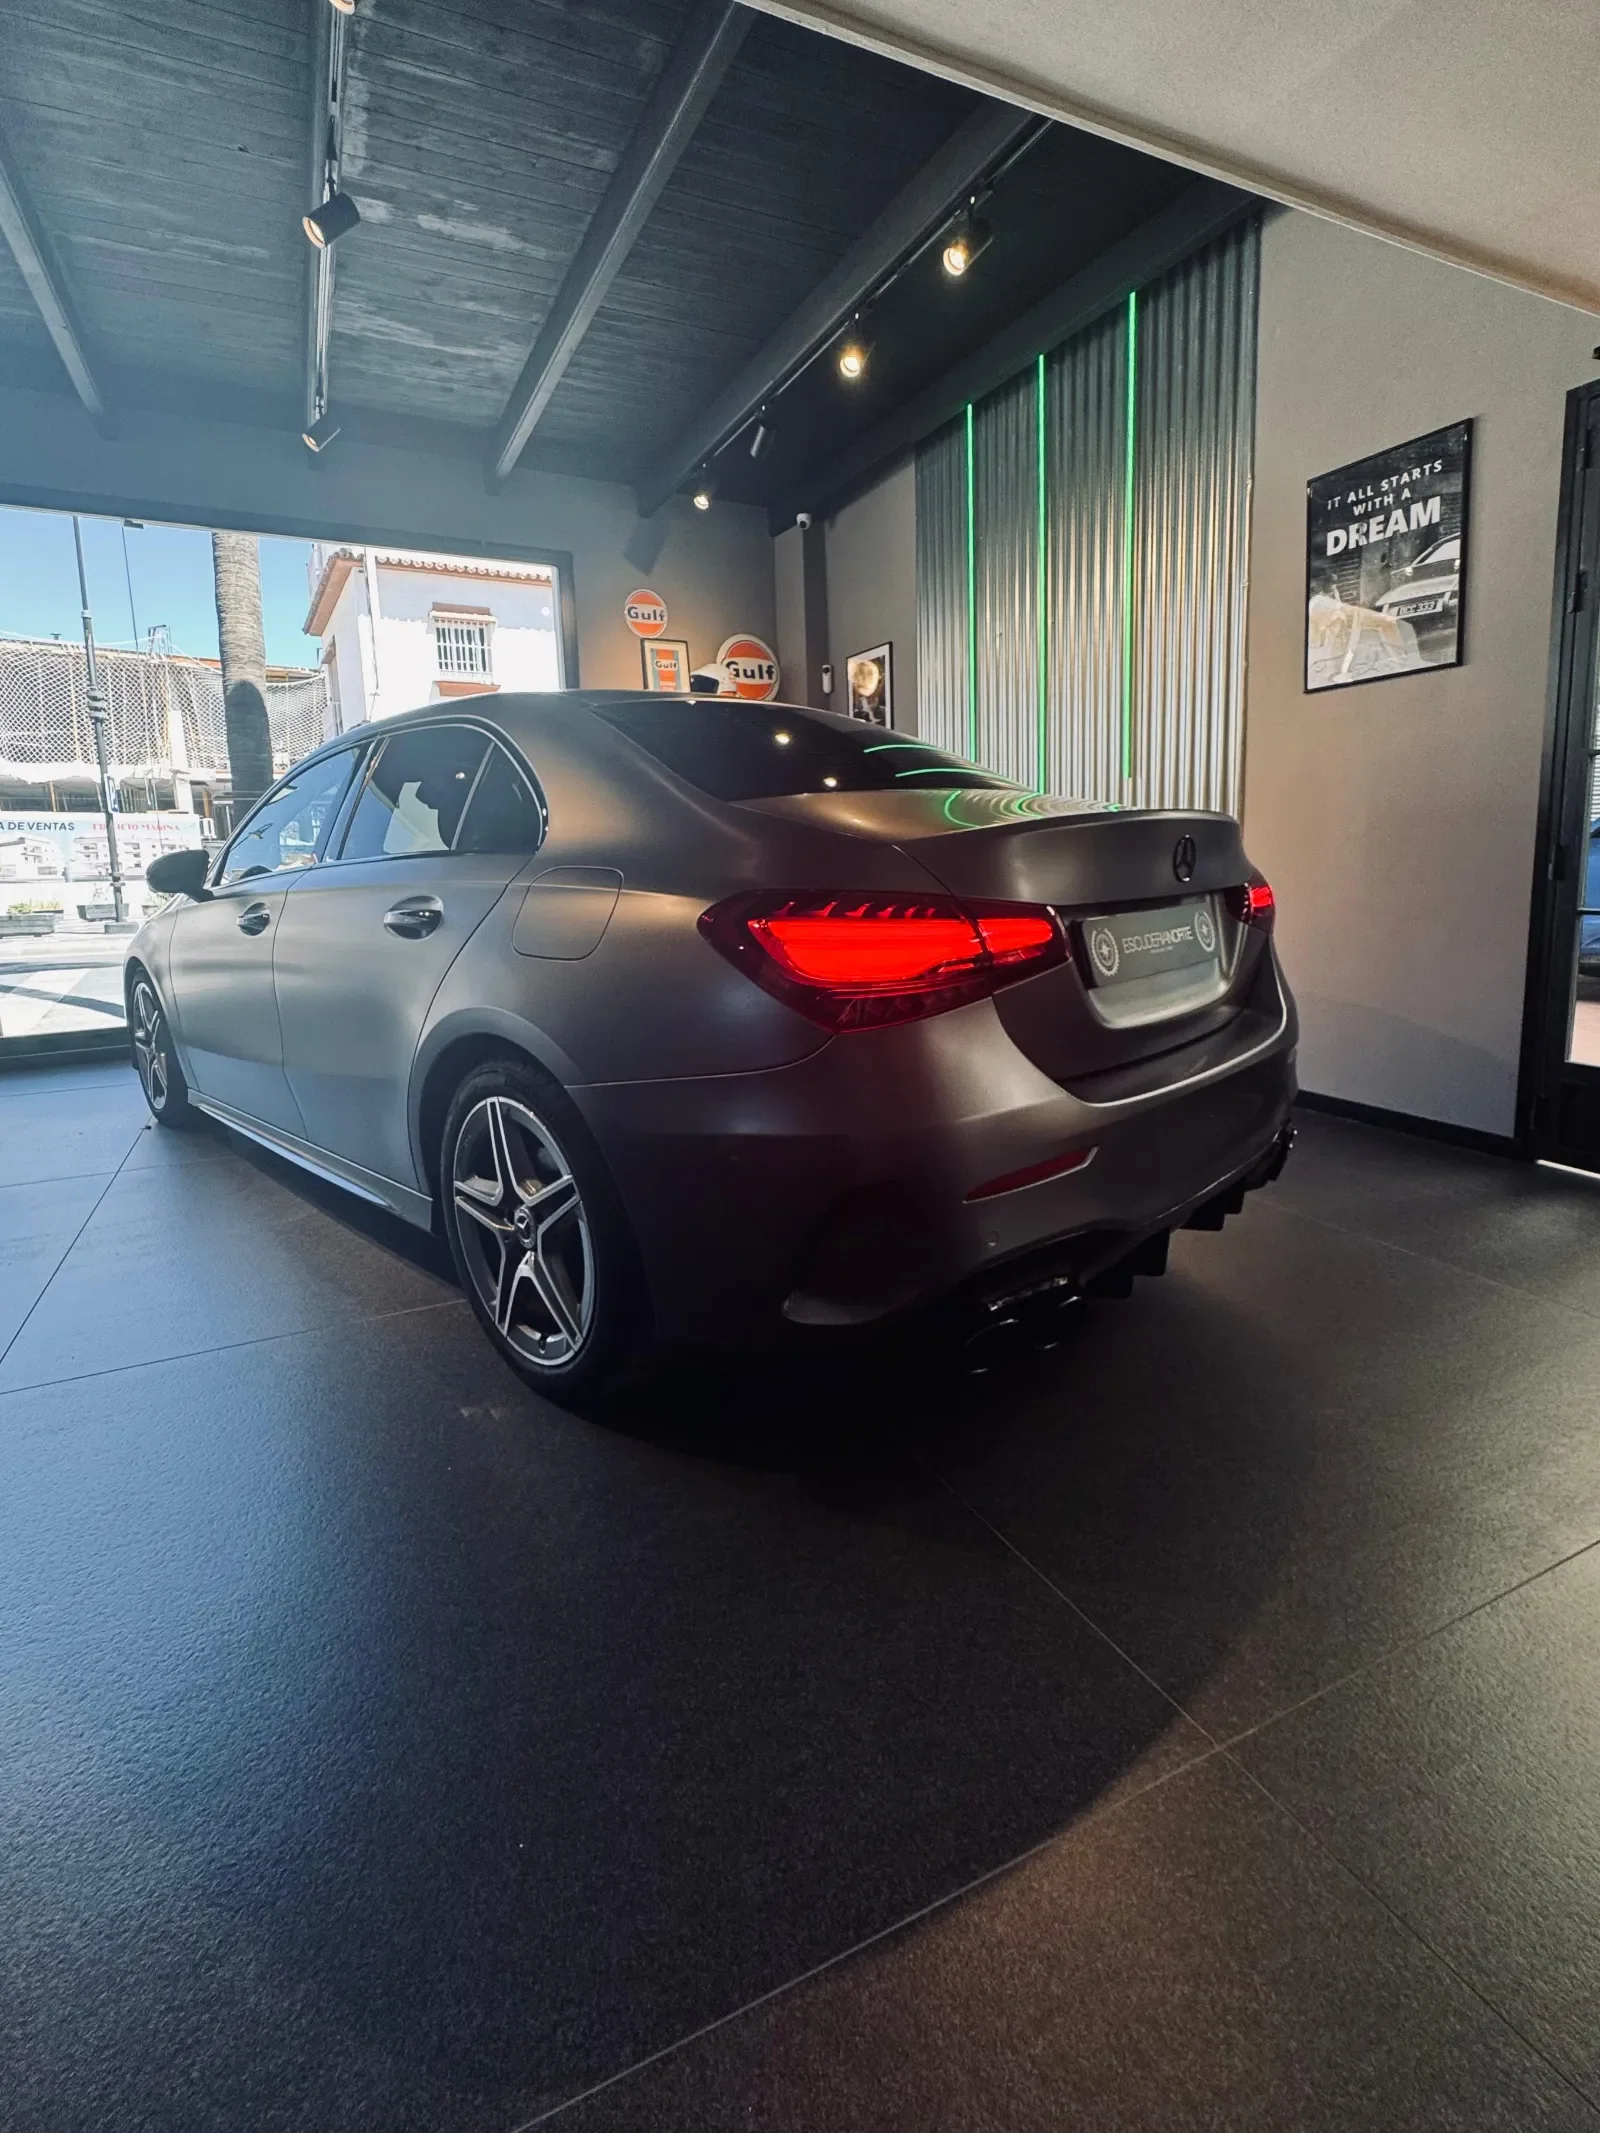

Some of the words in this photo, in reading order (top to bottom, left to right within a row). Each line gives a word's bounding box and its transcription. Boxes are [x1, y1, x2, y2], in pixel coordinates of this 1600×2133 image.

[1328, 496, 1341, 510] IT
[1347, 485, 1374, 504] ALL
[1381, 459, 1442, 492] STARTS
[1353, 493, 1393, 516] WITH
[1401, 488, 1411, 500] A
[1327, 496, 1440, 556] DREAM
[627, 606, 665, 621] Gulf
[655, 660, 677, 669] Gulf
[725, 661, 775, 680] Gulf
[8, 822, 25, 830] DE
[27, 822, 75, 831] VENTAS
[93, 823, 139, 831] EDICIO
